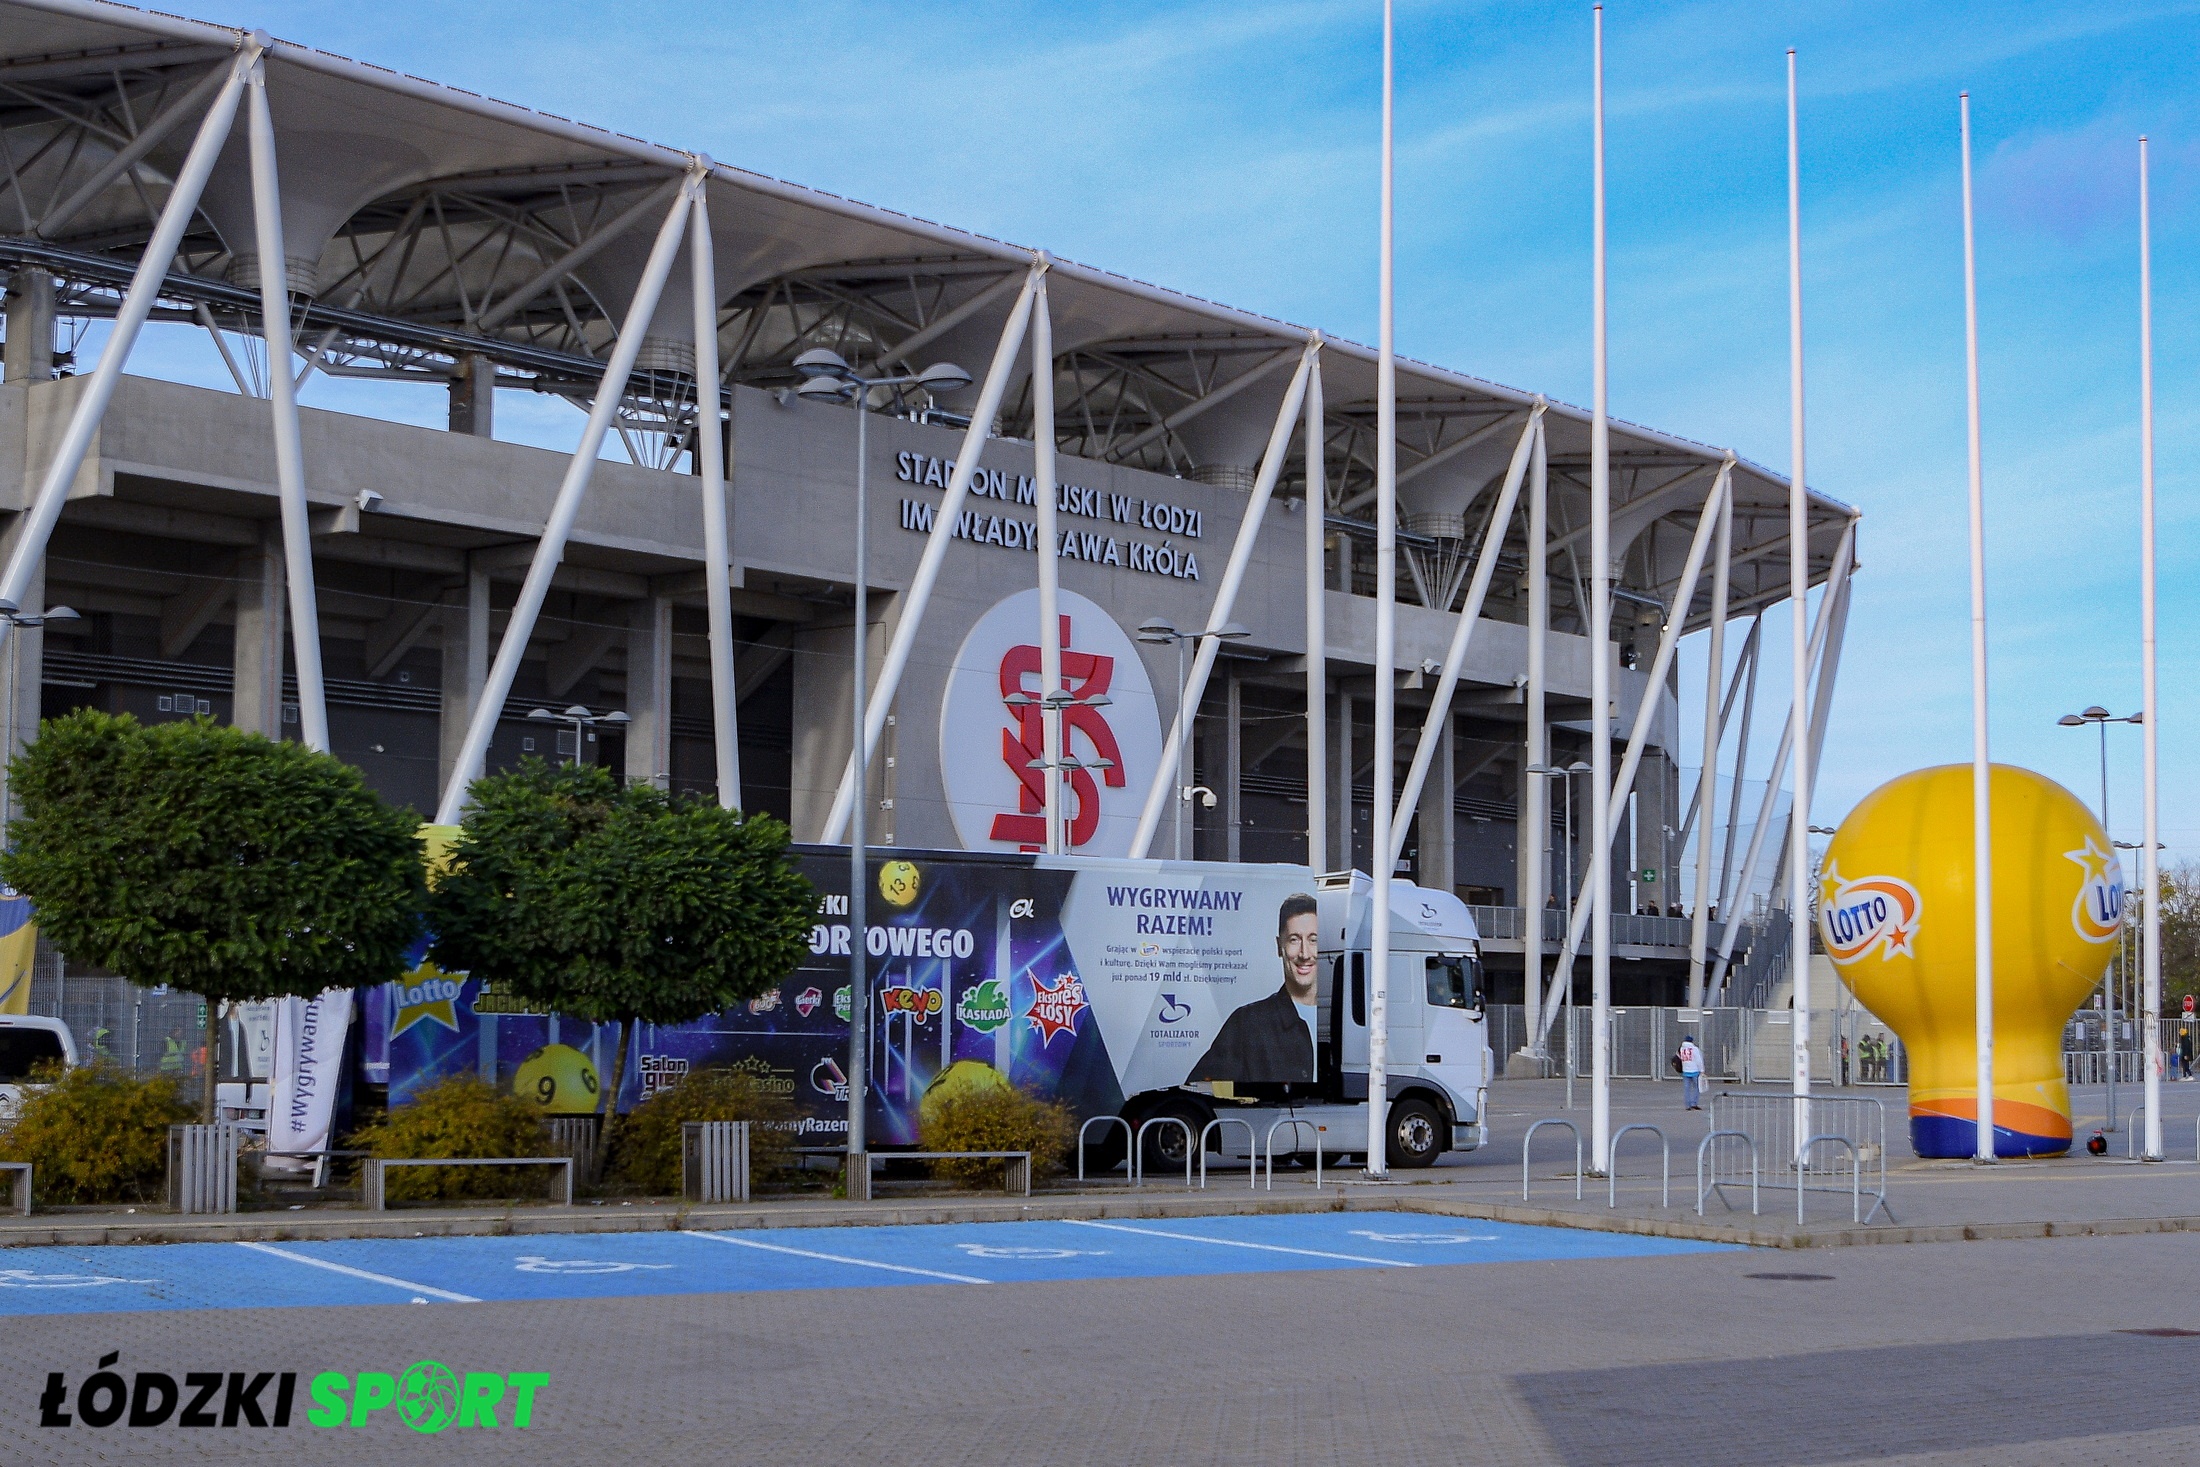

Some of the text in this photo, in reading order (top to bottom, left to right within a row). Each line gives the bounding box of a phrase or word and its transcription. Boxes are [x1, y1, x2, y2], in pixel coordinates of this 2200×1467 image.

[1016, 475, 1101, 518] MJSKI
[1110, 493, 1131, 523] W
[1141, 500, 1202, 538] ŁODZI
[952, 510, 1121, 567] WŁADYAWA
[1129, 540, 1200, 580] KRÓLA
[1107, 886, 1243, 911] WYGRYWAMY
[1137, 914, 1213, 936] RAZEM!
[1826, 896, 1887, 945] LOTTO
[1106, 945, 1128, 956] Grając
[1201, 948, 1223, 957] polski
[1225, 949, 1242, 957] sport
[1158, 960, 1177, 968] Wam
[1124, 973, 1148, 983] ponad
[1149, 972, 1160, 981] 19
[1163, 971, 1182, 982] mld
[397, 979, 457, 1008] Lotto
[957, 1004, 1011, 1021] KASKADA
[1040, 1003, 1074, 1027] LOSY
[1150, 1030, 1200, 1039] TOTALIZATOR
[641, 1055, 688, 1072] Salon
[535, 1076, 556, 1106] 9
[581, 1068, 598, 1094] 6
